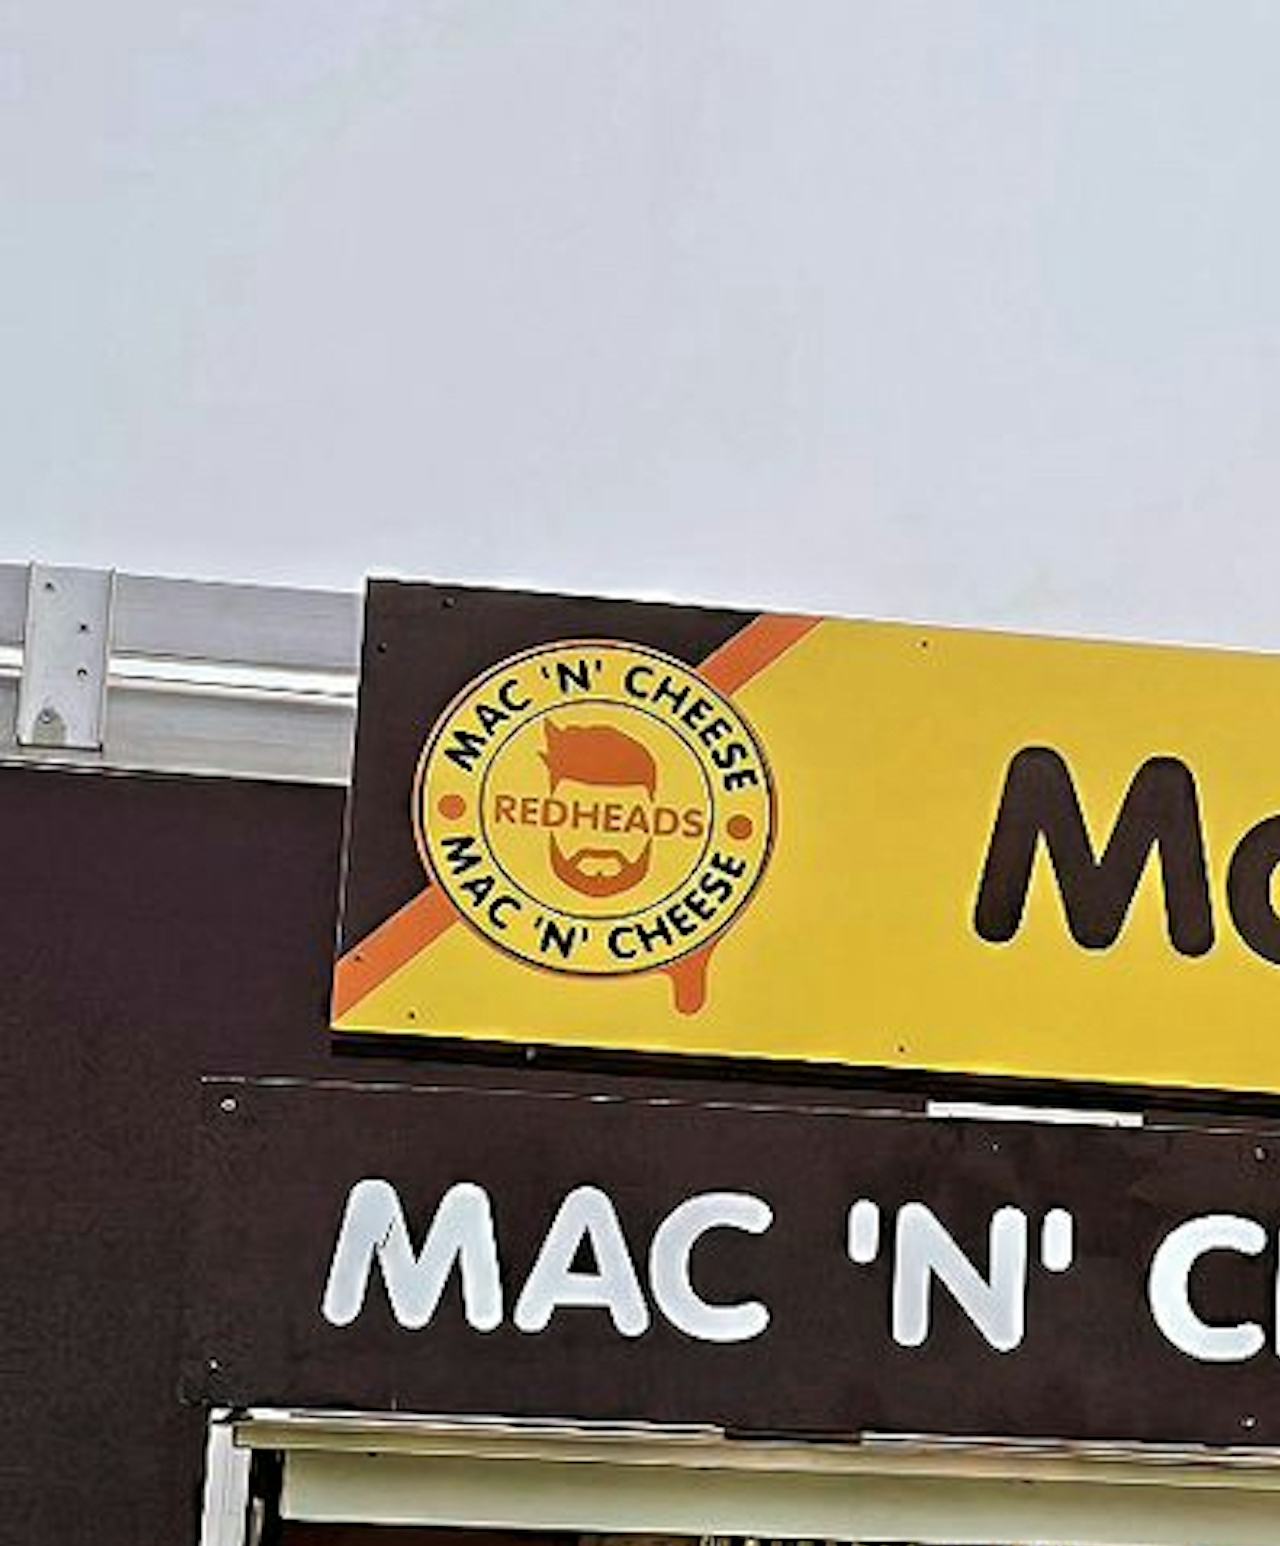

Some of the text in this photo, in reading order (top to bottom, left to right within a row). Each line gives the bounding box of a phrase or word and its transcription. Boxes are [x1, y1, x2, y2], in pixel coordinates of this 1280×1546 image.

[444, 679, 531, 772] MAC
[624, 665, 758, 792] CHEESE
[494, 795, 703, 837] REDHEADS
[441, 835, 521, 929] MAC
[607, 852, 746, 958] CHEESE
[322, 1179, 773, 1342] MAC
[847, 1199, 1073, 1352] 'N'
